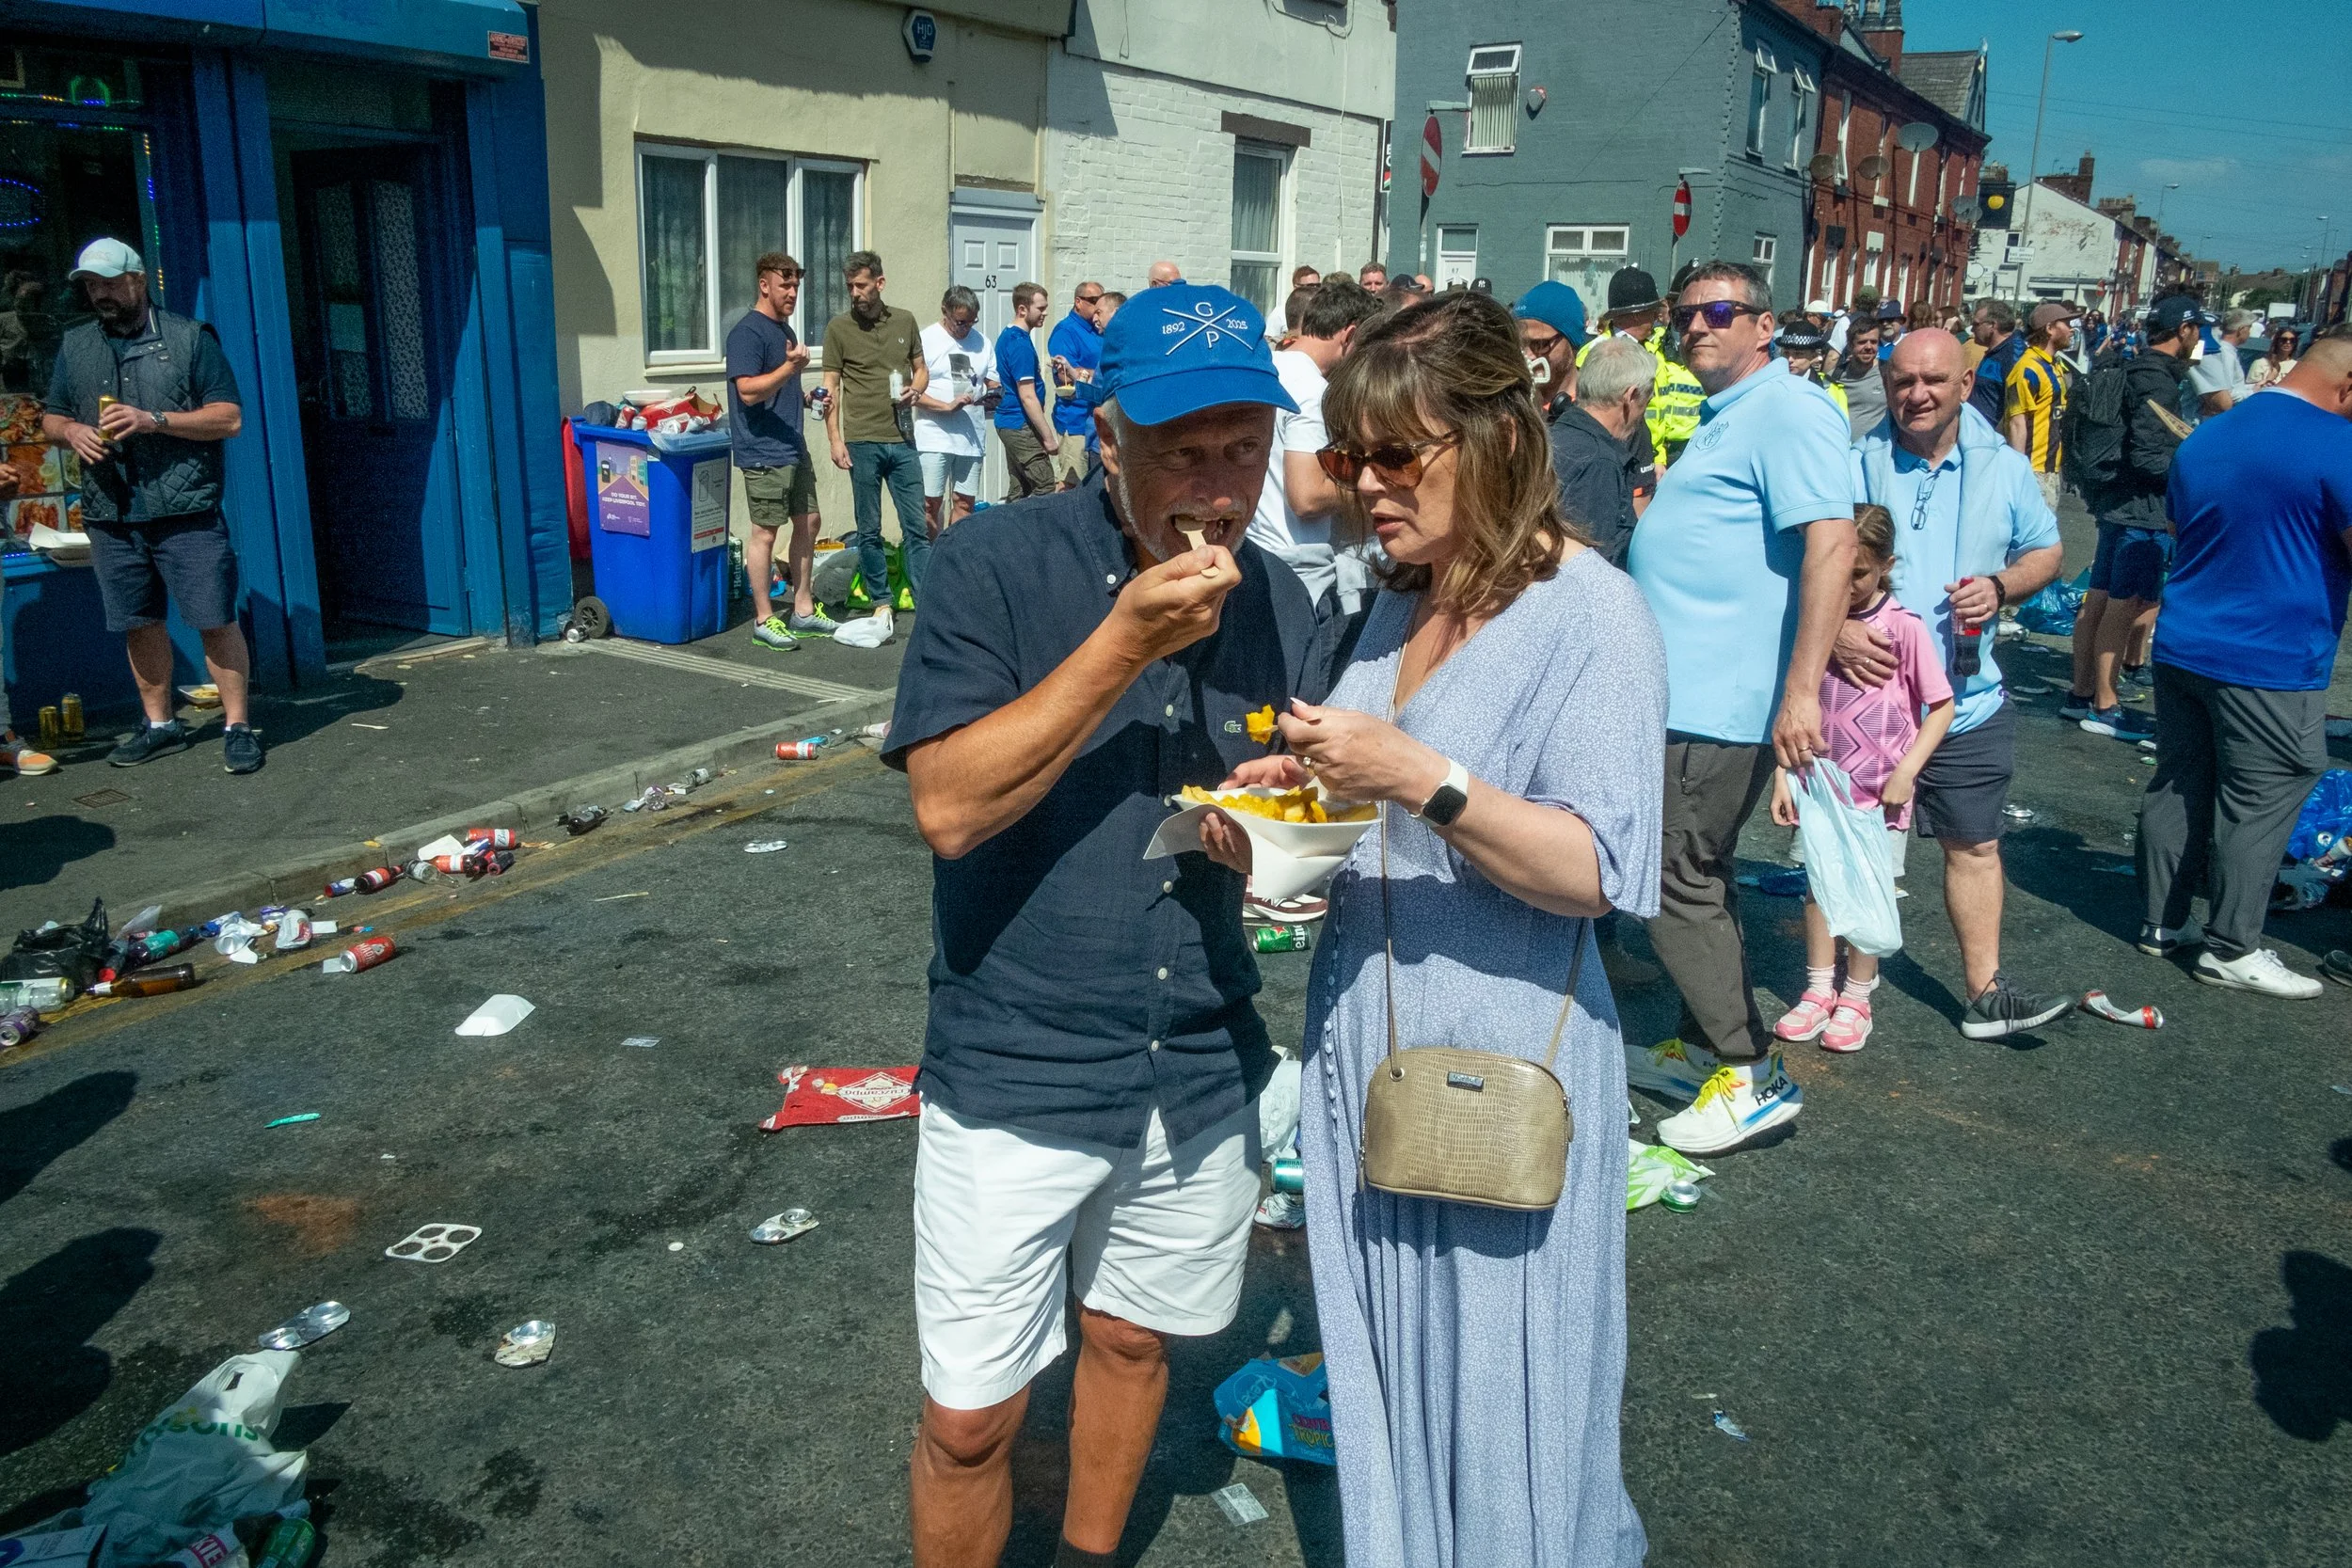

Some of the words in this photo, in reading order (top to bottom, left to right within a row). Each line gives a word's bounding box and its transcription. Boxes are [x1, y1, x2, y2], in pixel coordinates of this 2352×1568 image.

[985, 275, 997, 289] 63
[1195, 301, 1214, 317] G
[1162, 321, 1185, 335] 1892
[1206, 330, 1219, 349] P
[612, 498, 636, 506] LIVERPOOL
[1755, 1075, 1788, 1106] HOKA
